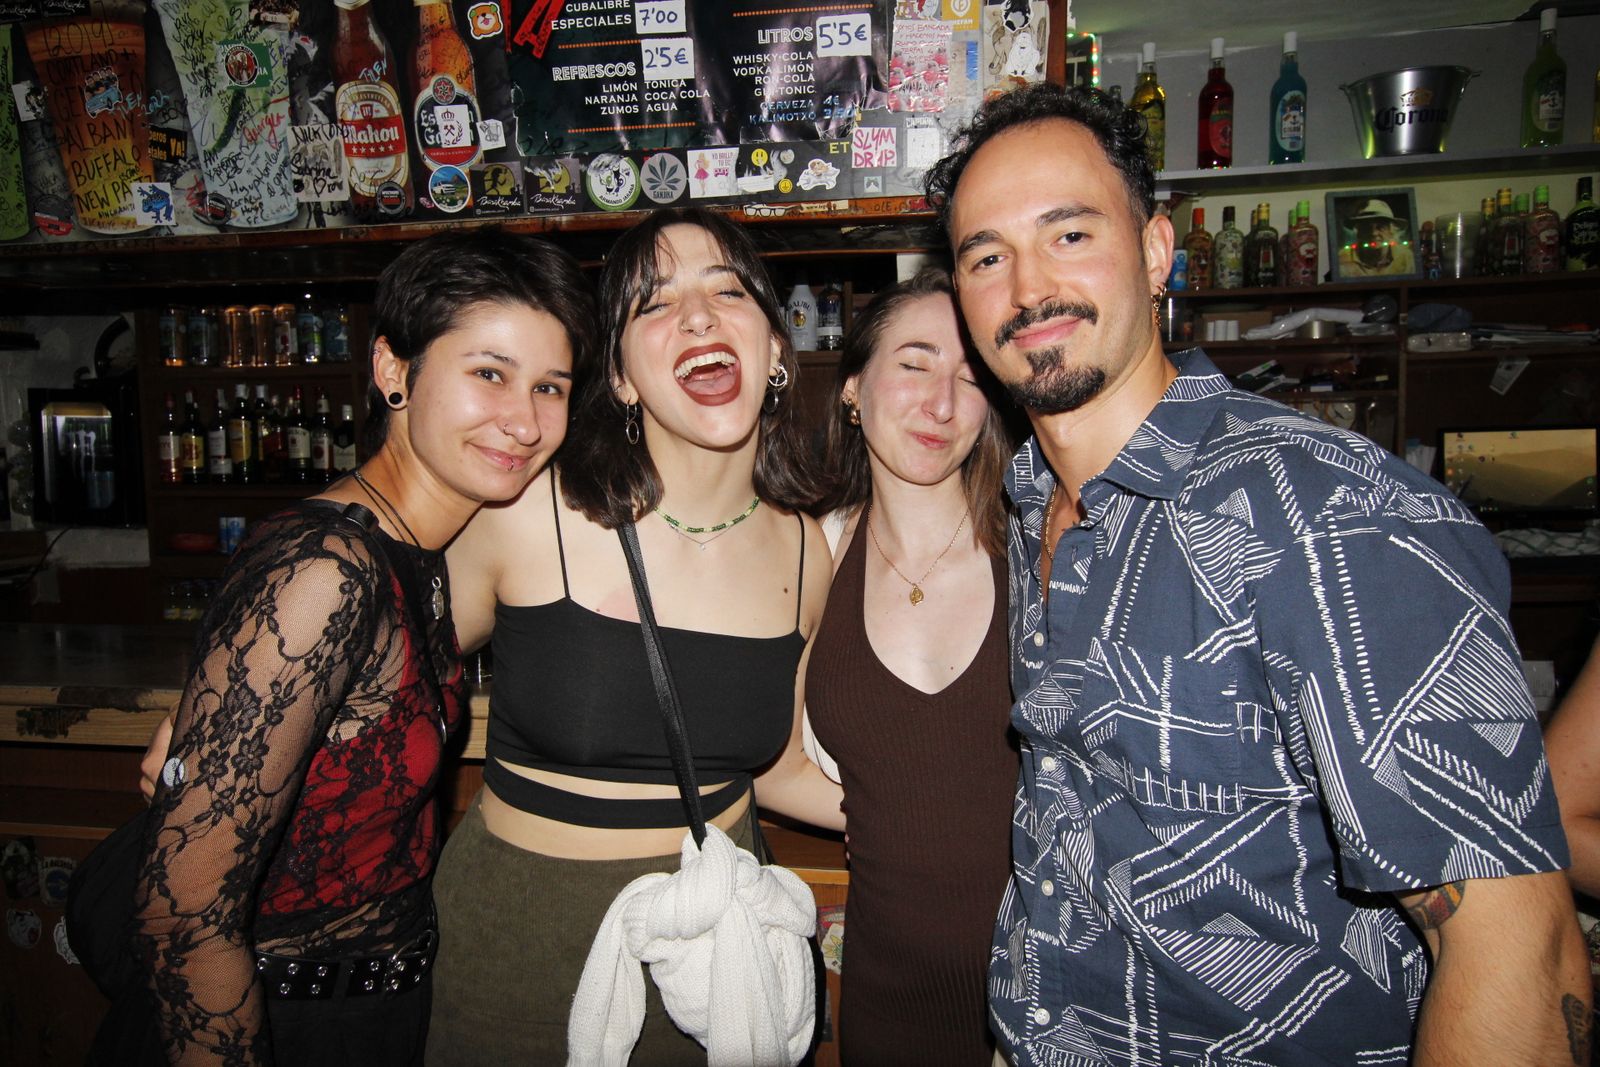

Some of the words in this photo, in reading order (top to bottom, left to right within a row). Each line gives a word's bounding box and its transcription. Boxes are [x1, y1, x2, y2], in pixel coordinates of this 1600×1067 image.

[566, 0, 631, 13] CUBALIBRE
[551, 14, 632, 30] ESPECIALES
[639, 8, 678, 27] 7'00
[757, 26, 814, 45] LITROS
[818, 22, 868, 49] 5'5€
[644, 47, 689, 69] 2'5€
[552, 62, 637, 81] REFRESCOS
[602, 81, 638, 93] LIMÓN
[585, 94, 638, 105] NARANJA
[644, 91, 677, 101] COCA
[679, 89, 711, 99] COLA
[759, 99, 814, 110] CERVEZA
[600, 105, 639, 115] ZUMOS
[646, 102, 678, 112] AGUA
[750, 111, 816, 124] KALIMOTXO
[1375, 106, 1449, 133] Corona
[66, 111, 135, 154] ALBANY
[344, 124, 399, 144] Mahou
[71, 145, 142, 187] BUFFALO
[76, 184, 111, 213] NEW
